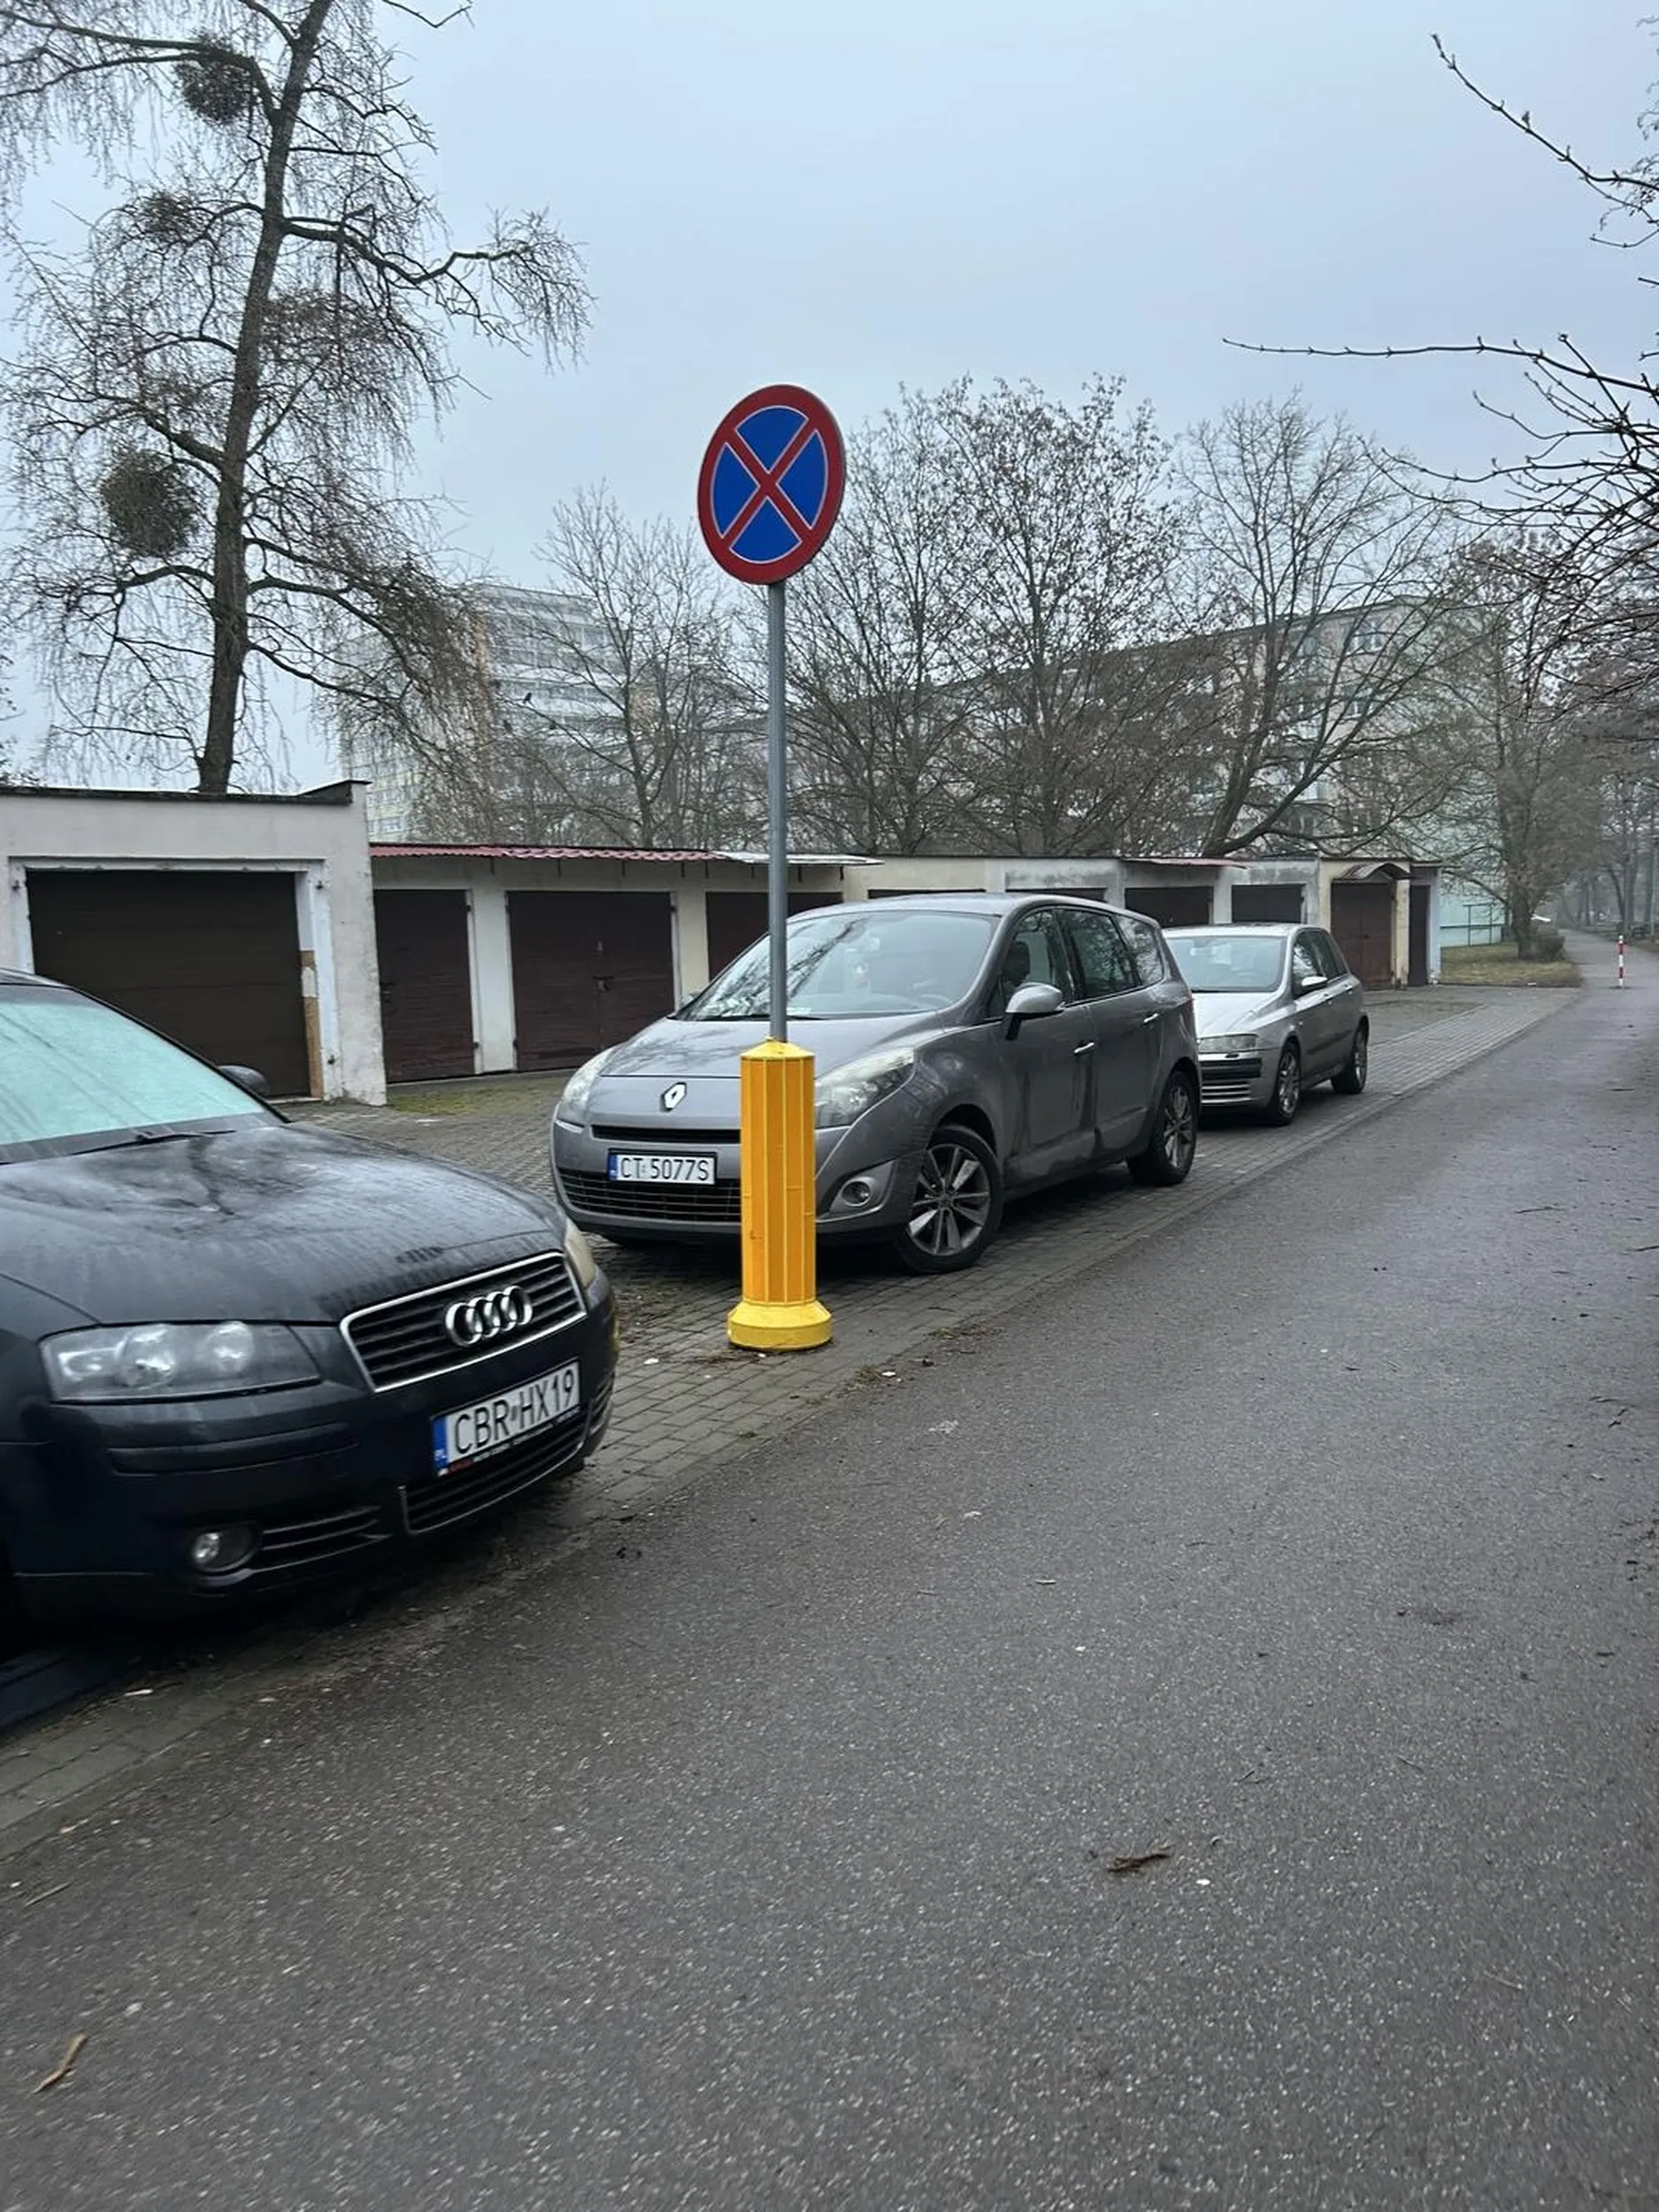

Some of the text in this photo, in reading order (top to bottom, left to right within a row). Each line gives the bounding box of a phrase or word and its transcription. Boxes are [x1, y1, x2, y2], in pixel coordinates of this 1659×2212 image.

[621, 1157, 709, 1180] CT 5077S
[455, 1399, 509, 1454] CBR
[519, 1370, 574, 1429] HX19
